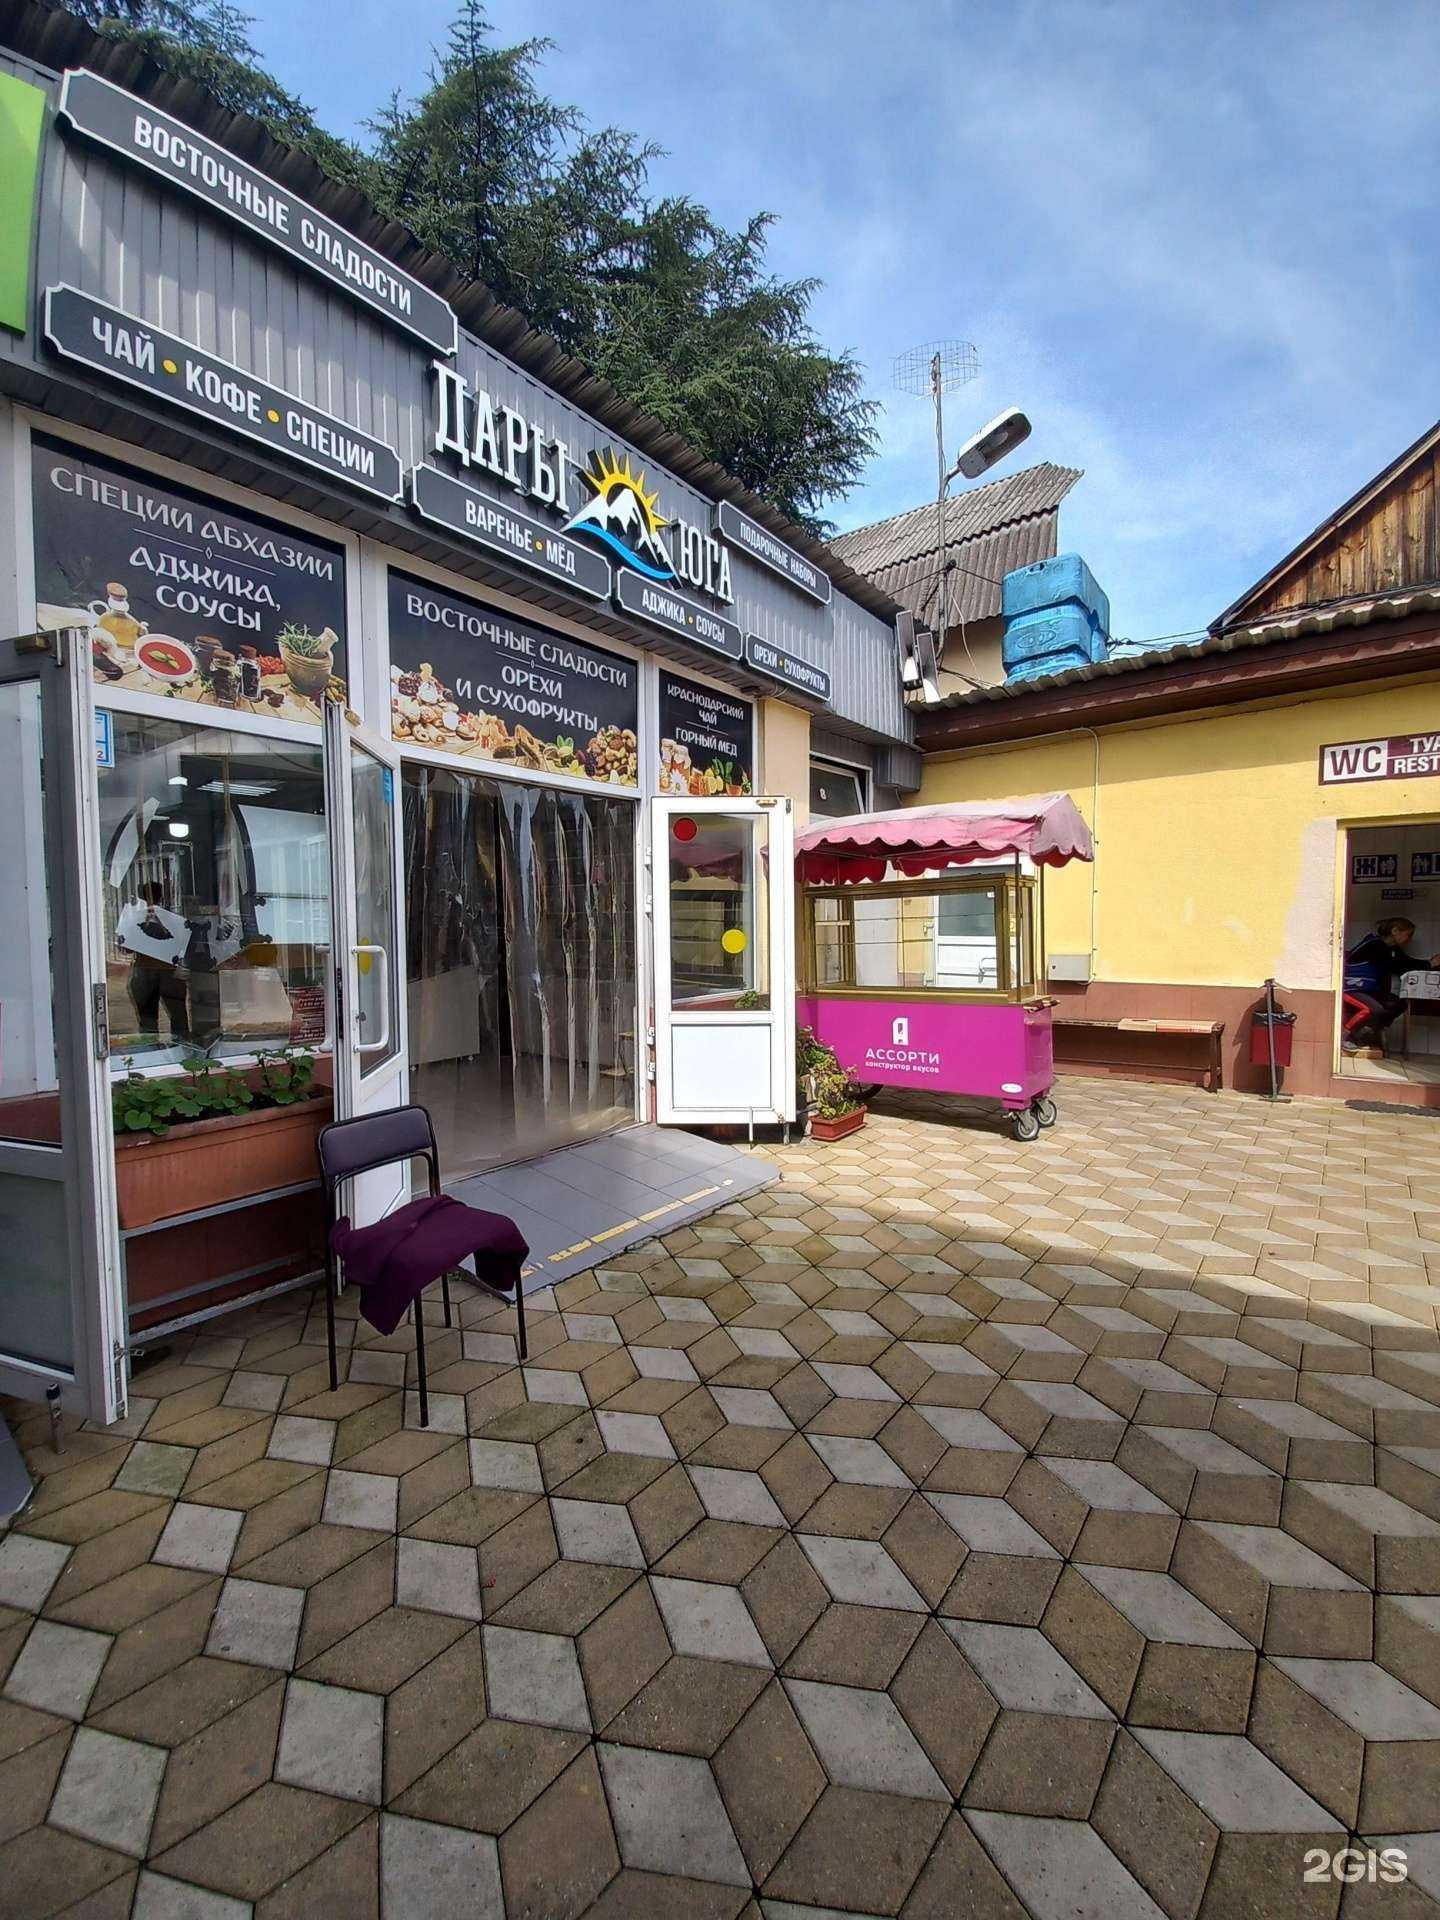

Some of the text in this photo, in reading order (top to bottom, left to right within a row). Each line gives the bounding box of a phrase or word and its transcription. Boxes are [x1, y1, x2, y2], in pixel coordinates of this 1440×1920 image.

[134, 115, 412, 316] ВОСТОЧНЫЕ СЛАДОСТИ
[92, 316, 375, 478] ЧАЙ КОФЕ СПЕЦИИ
[432, 359, 734, 605] ДАРЫ ЮГА
[50, 466, 333, 581] СПЕЦИИ АБХАЗИИ
[465, 499, 576, 577] ВАРЕНЬЕ МЁД
[129, 546, 281, 612] АДЖИКА,
[740, 521, 817, 589] ПОДАРОЧНЫЕ НАБОРЫ
[155, 584, 261, 632] СОУСЫ
[642, 588, 725, 644] АДЖИКА СОУСЫ
[407, 593, 627, 688] ВОСТОЧНЫЕ СЛАДОСТИ
[753, 643, 826, 692] ОРЕХИ СУХОФРУКТЫ
[456, 677, 598, 732] И СУХОФРУКТЫ
[501, 665, 562, 700] ОРЕХИ
[667, 683, 744, 720] КРАСНОДАРСКИЙ
[675, 727, 738, 758] ГОРНЫЙ МЕД
[698, 709, 717, 726] ЧАЙ
[1330, 745, 1382, 776] WC
[865, 1048, 940, 1065] АССОРТИ
[865, 1061, 940, 1074] конструктор вкусов
